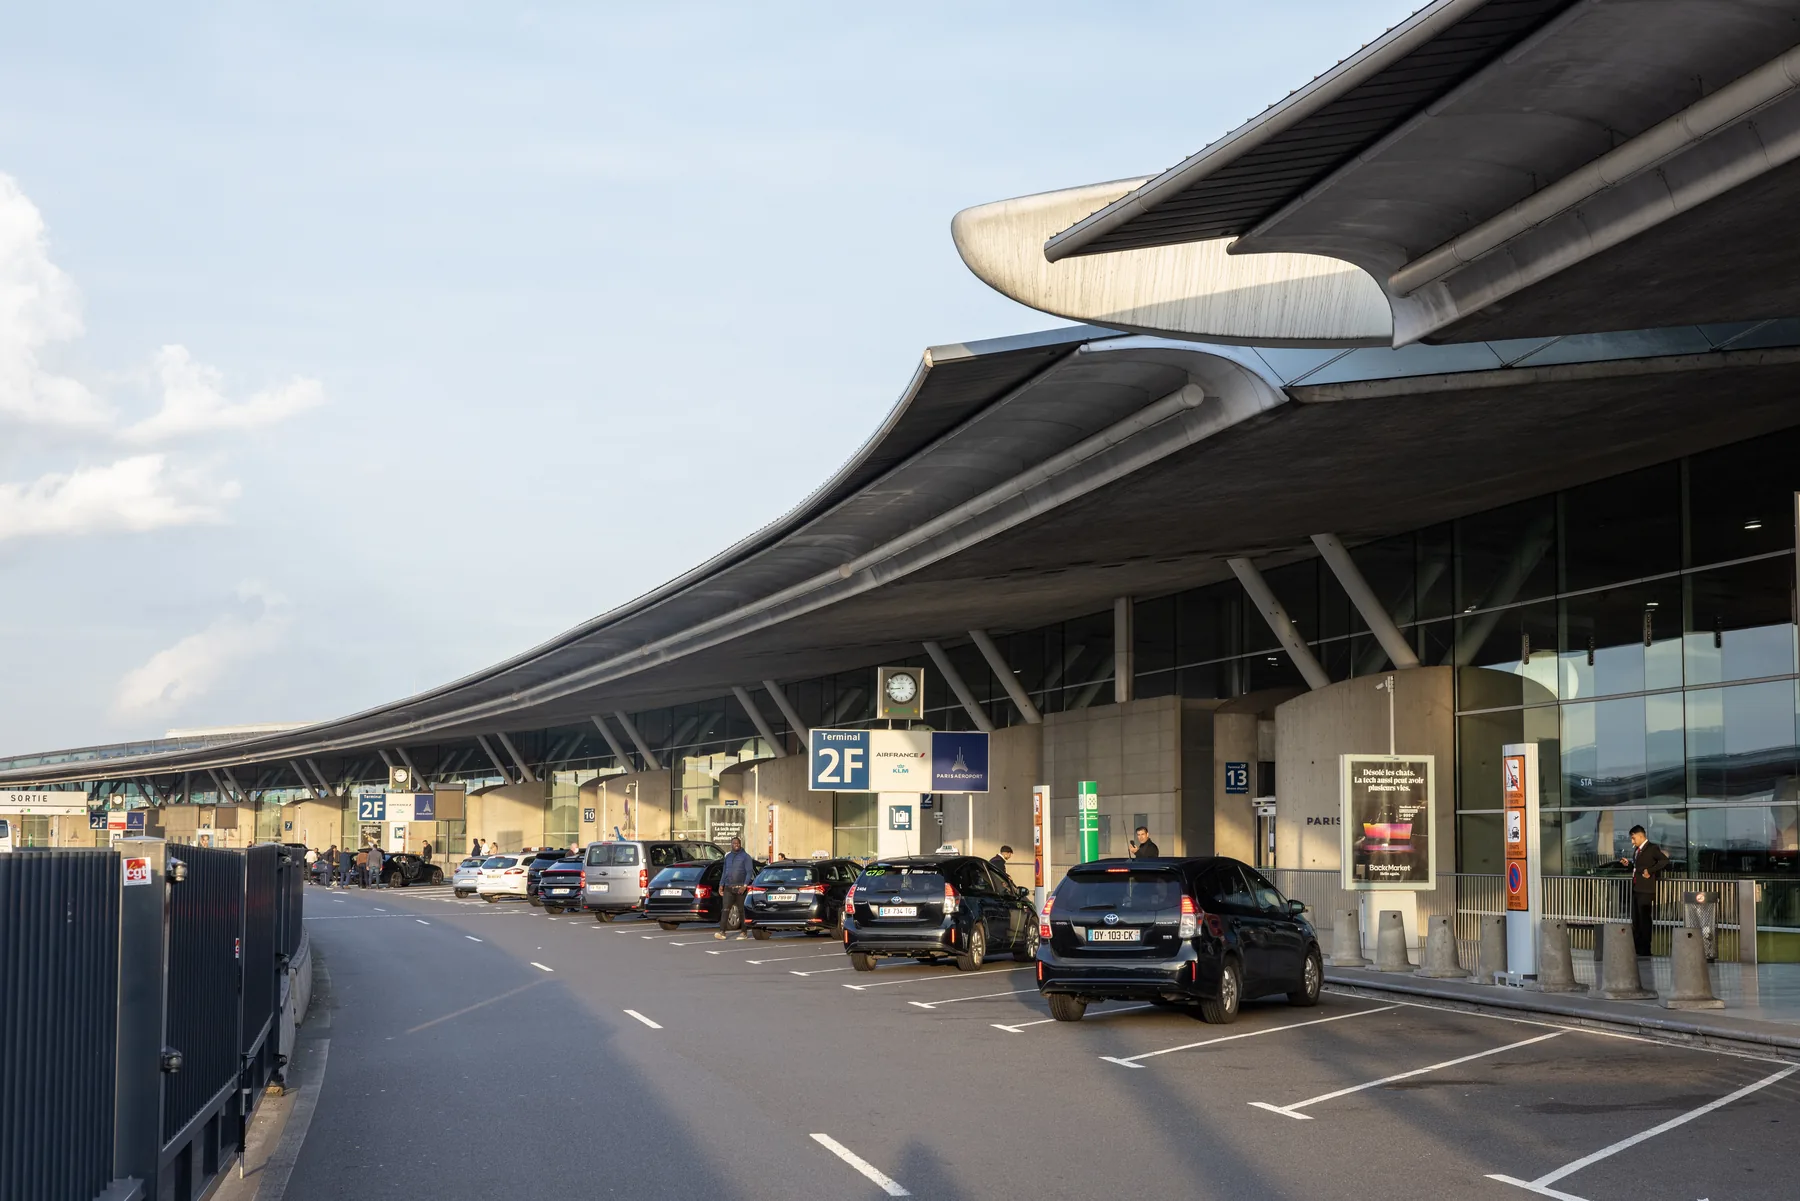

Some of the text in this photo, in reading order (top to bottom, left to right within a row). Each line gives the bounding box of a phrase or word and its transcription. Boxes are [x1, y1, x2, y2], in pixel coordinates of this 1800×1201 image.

[821, 732, 861, 741] Terminal
[817, 747, 864, 784] 2F
[1363, 768, 1385, 776] Désolé
[1227, 769, 1247, 786] 13
[1354, 776, 1363, 784] La
[1363, 776, 1376, 784] tech
[1368, 784, 1396, 792] plusieurs
[10, 794, 48, 802] SORTIE
[361, 801, 384, 818] 2F
[584, 811, 595, 820] 10
[91, 816, 107, 828] 2F
[127, 865, 147, 879] cgt
